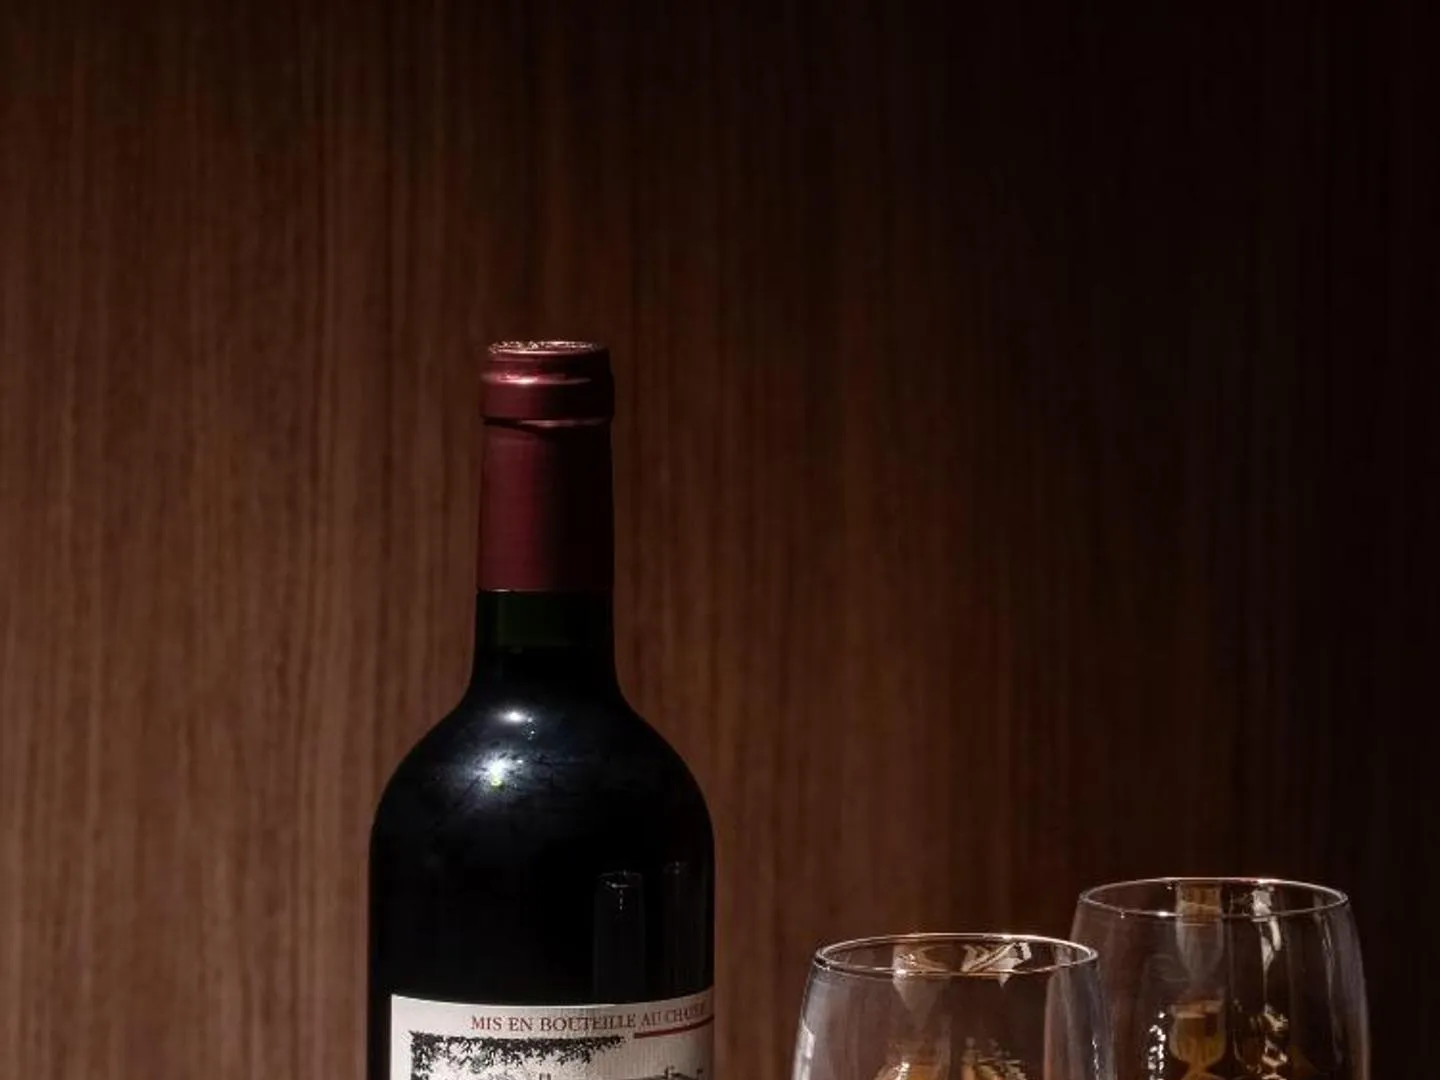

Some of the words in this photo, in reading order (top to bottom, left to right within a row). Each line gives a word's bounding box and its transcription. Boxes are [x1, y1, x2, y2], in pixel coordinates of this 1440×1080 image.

[471, 1015, 502, 1031] MIS
[508, 1016, 533, 1032] EN
[540, 1013, 636, 1032] BOUTEILLE
[641, 1011, 662, 1027] AU
